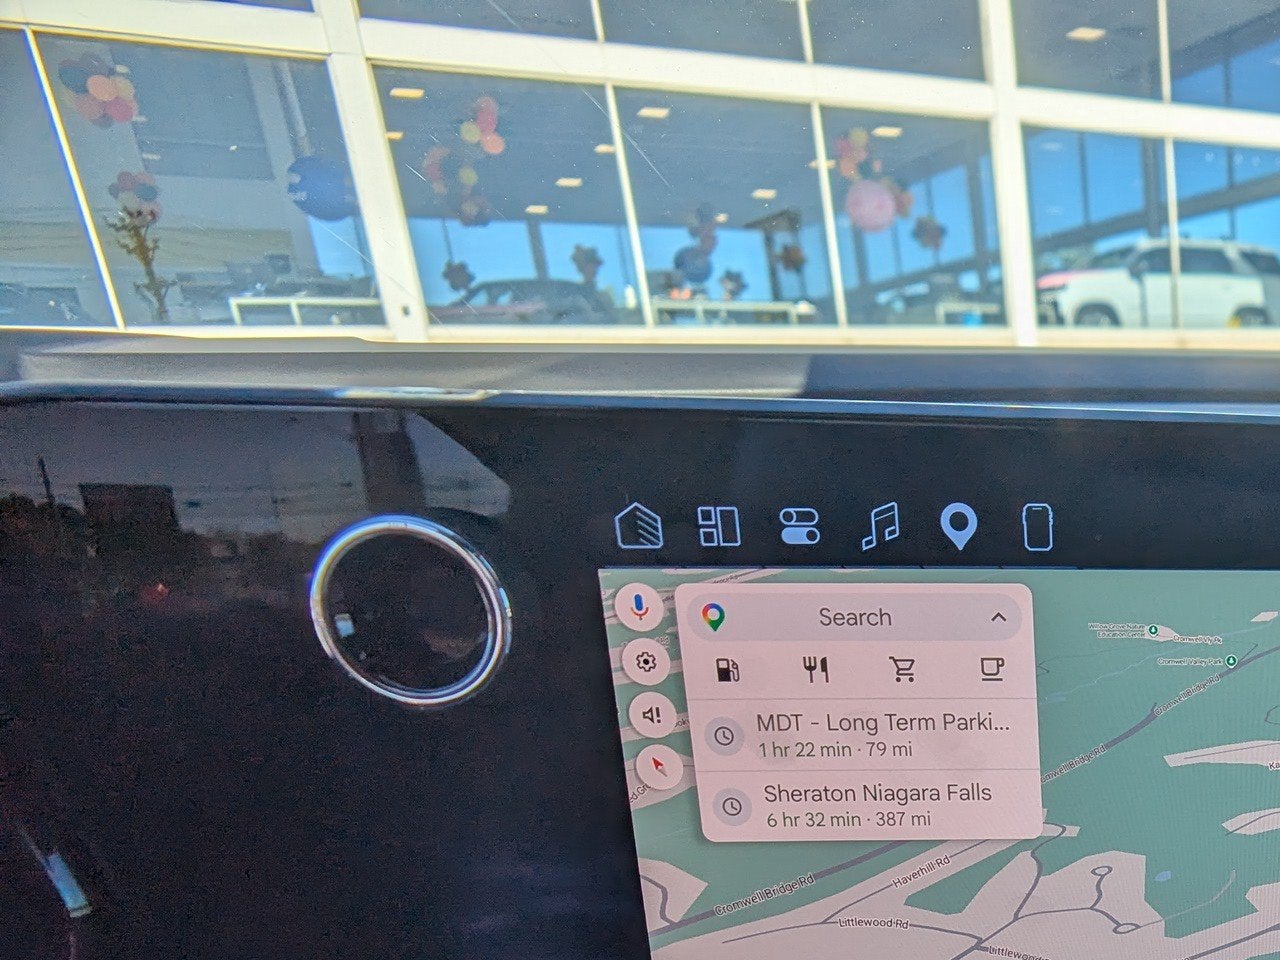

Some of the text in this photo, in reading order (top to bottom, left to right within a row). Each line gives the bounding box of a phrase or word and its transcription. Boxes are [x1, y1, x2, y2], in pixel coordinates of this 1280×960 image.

[819, 608, 892, 627] Search
[1189, 659, 1207, 667] Valley
[757, 714, 803, 732] MDT
[826, 714, 878, 736] Long
[885, 714, 936, 732] Term
[943, 713, 1010, 732] Parki...
[760, 742, 913, 758] 1 hr 22 min 79 mi
[1069, 751, 1094, 768] Bridge
[1094, 745, 1106, 757] Rd
[764, 783, 992, 806] Sheraton Niagara Falls
[767, 811, 931, 828] 6 hr 32 min 387 mi
[892, 855, 950, 888] Haverhill Rd
[714, 874, 815, 916] Cromwell Bridge Rd
[838, 918, 909, 929] Littlewood Rd
